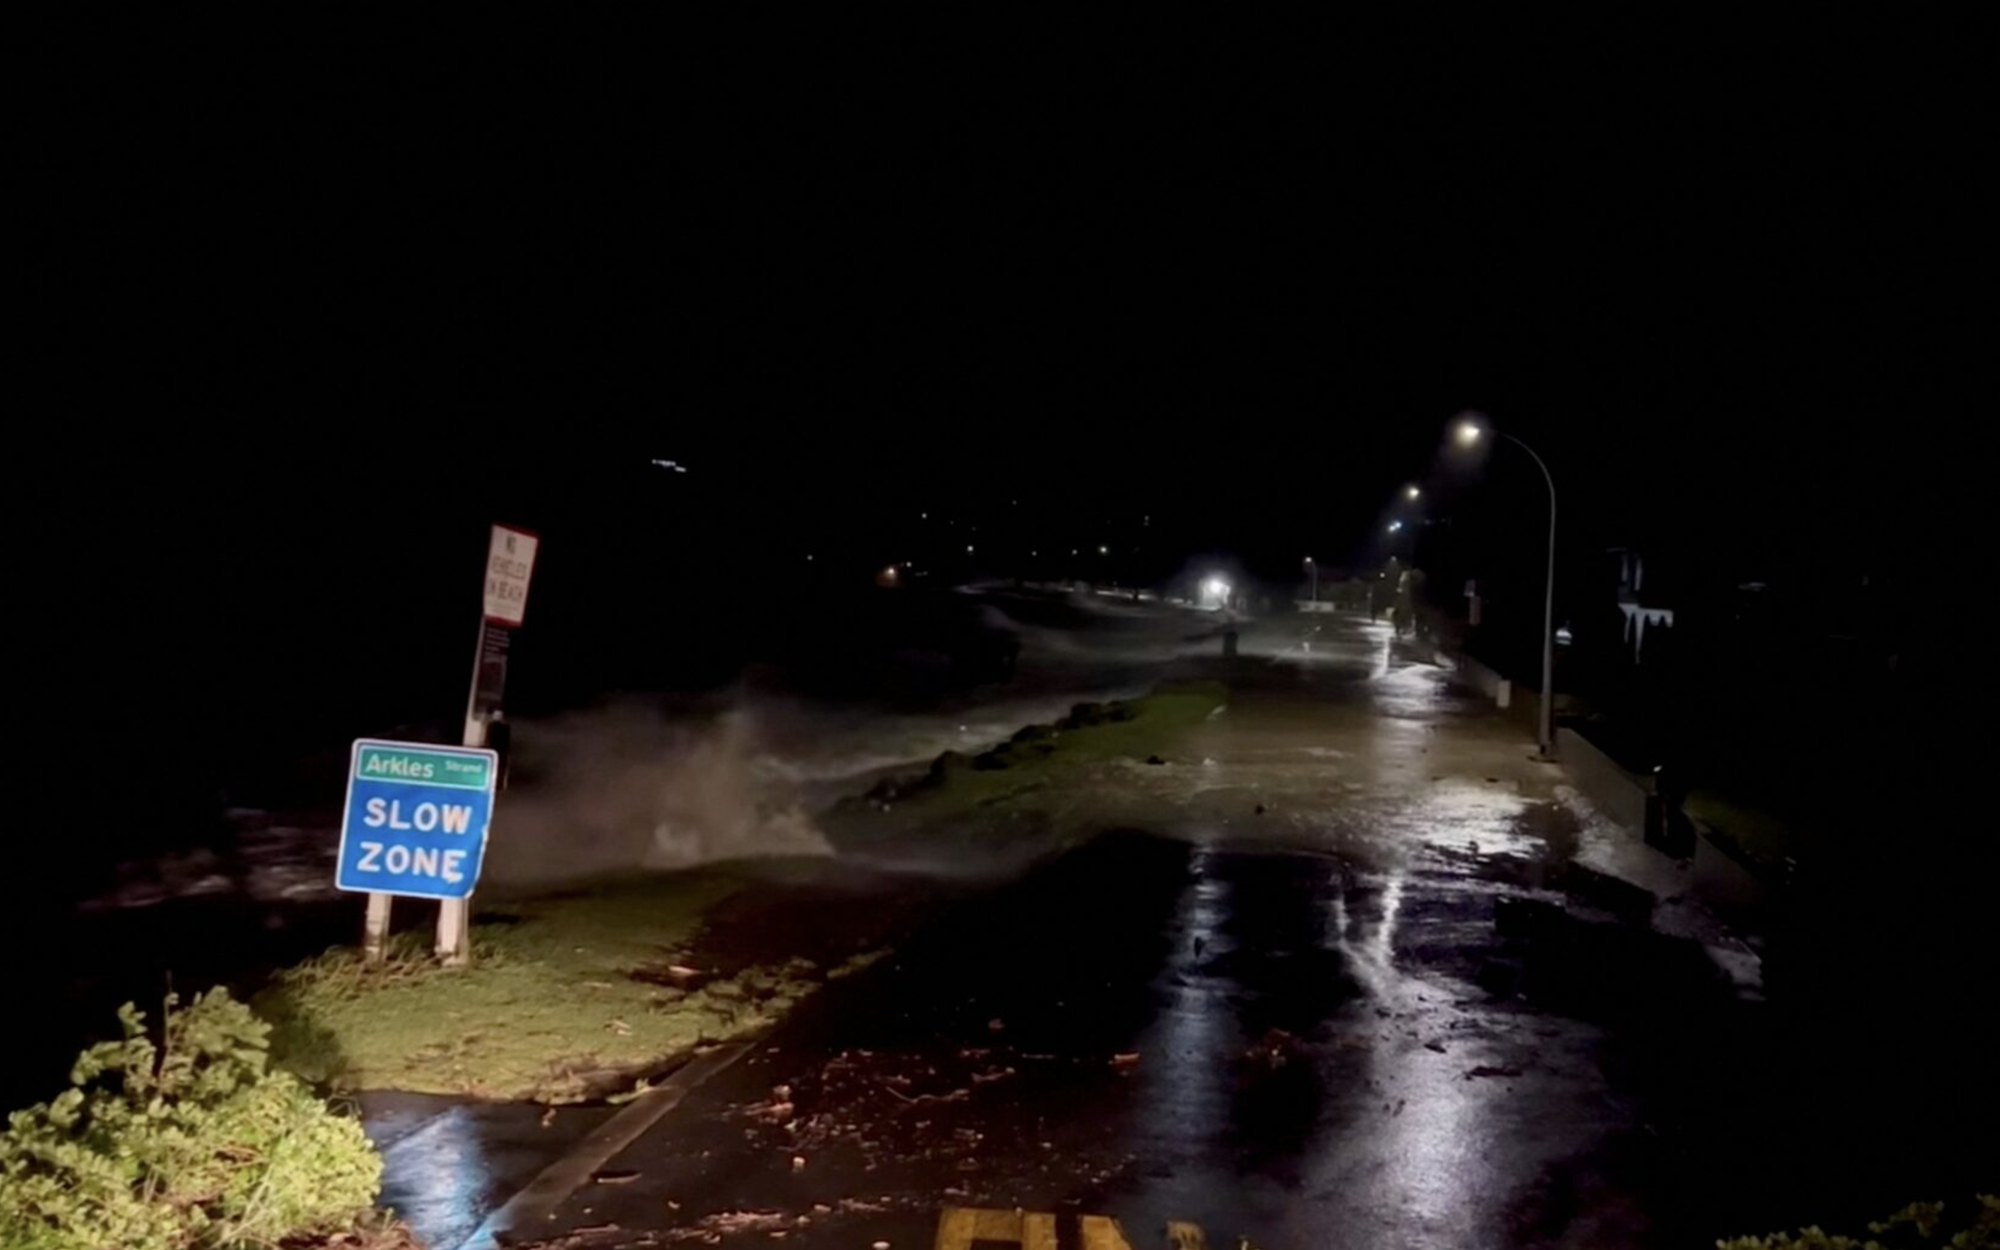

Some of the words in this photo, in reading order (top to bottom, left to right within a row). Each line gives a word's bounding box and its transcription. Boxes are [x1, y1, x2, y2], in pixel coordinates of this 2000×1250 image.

[365, 754, 434, 778] Arkles
[363, 797, 472, 835] SLOW
[356, 841, 467, 883] ZONE
